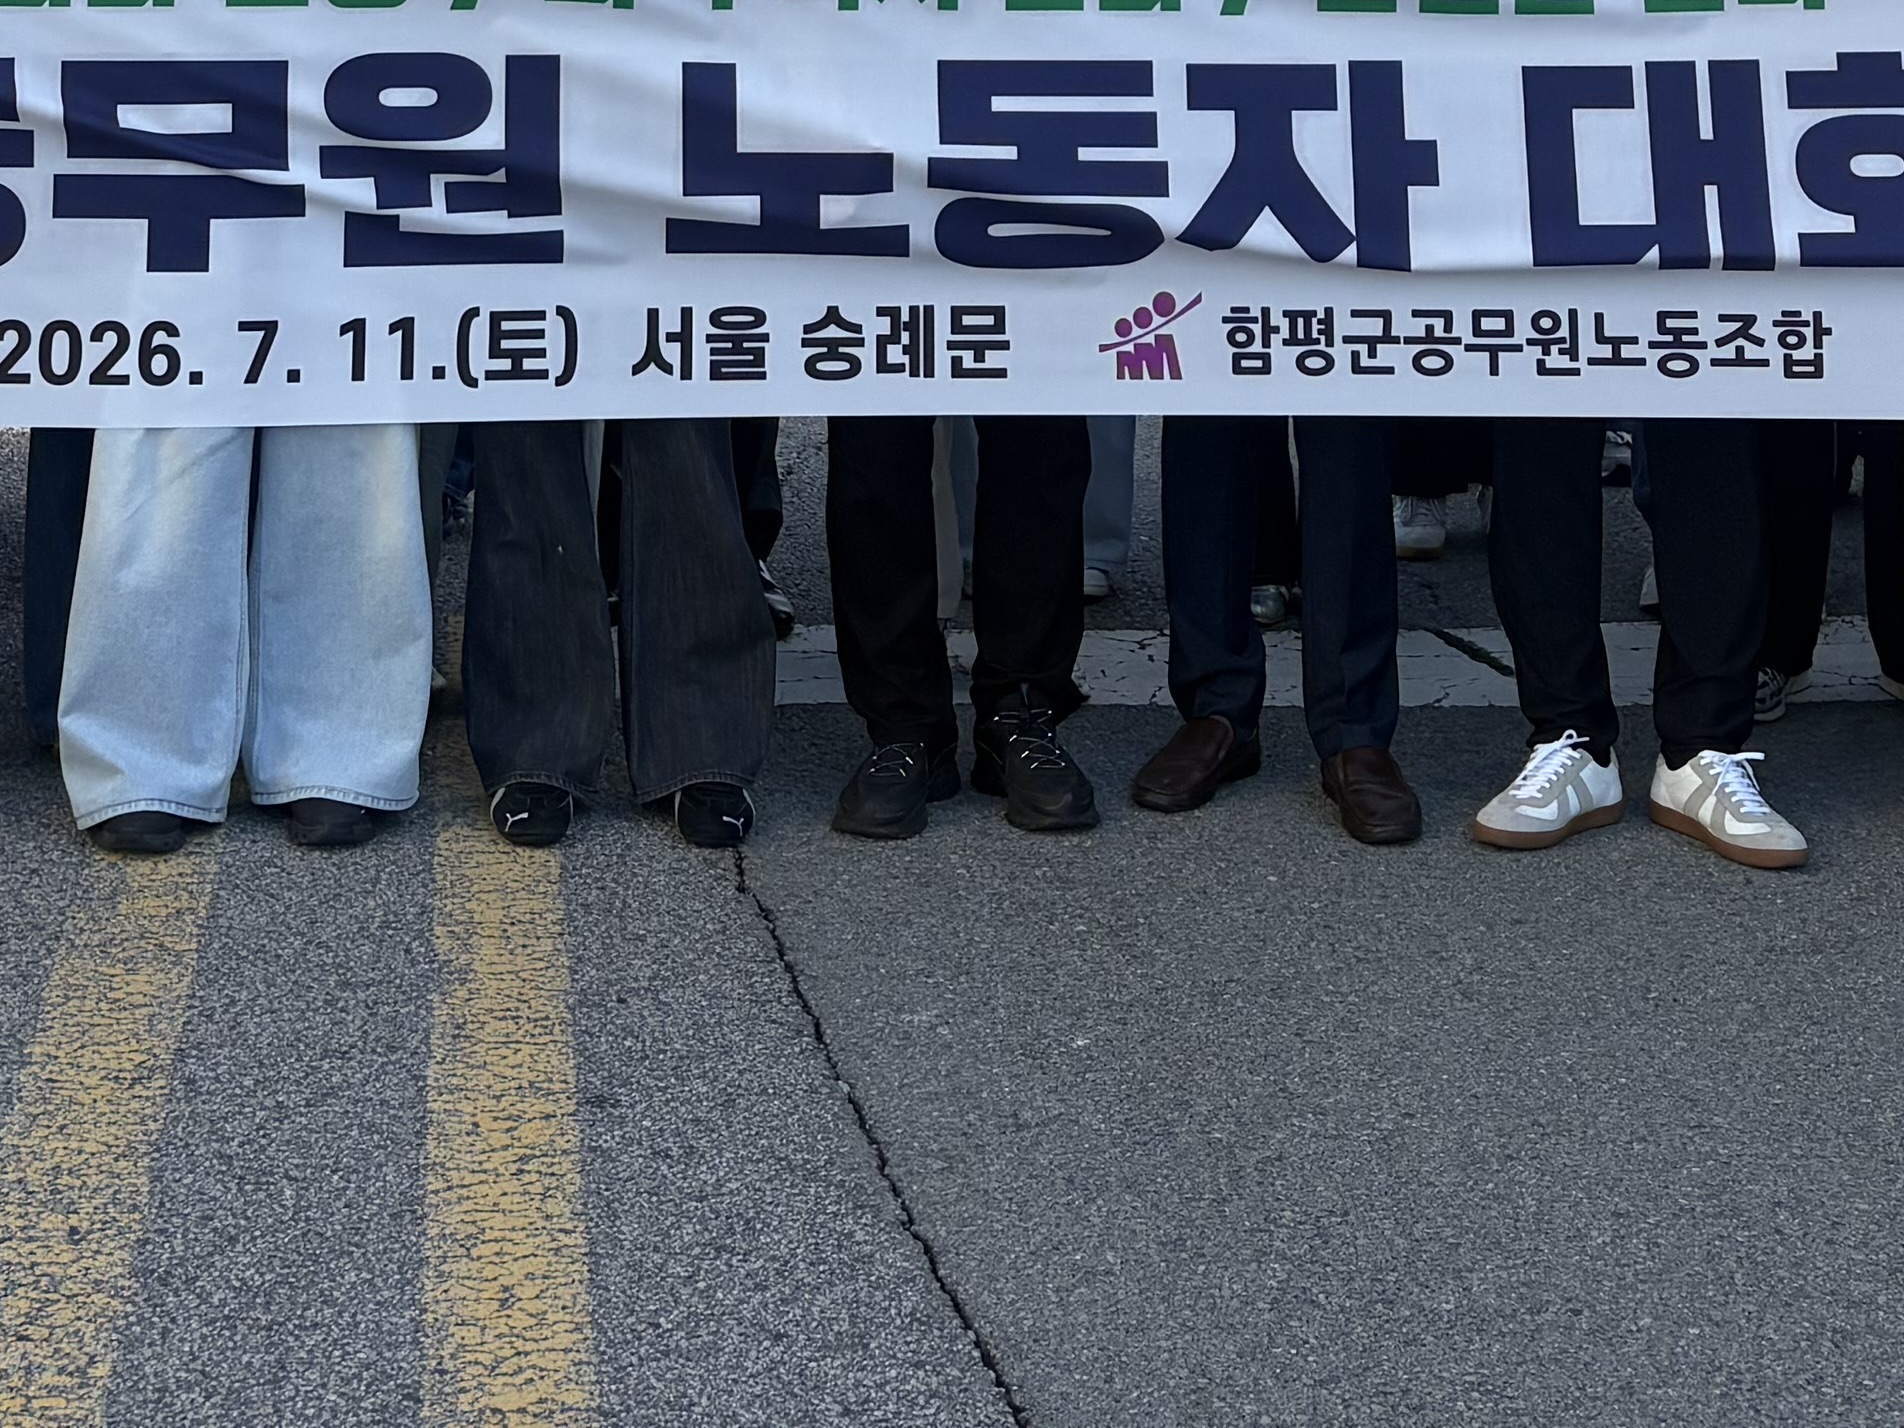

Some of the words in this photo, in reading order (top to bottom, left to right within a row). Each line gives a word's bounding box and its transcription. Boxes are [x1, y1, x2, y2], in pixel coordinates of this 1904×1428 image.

[666, 60, 1439, 273] 노동자
[238, 320, 300, 384] 7.
[340, 305, 577, 388] 11.(토)
[632, 305, 769, 382] 서울
[801, 304, 1010, 381] 숭례문
[1221, 305, 1833, 381] 함평군공무원노동조합
